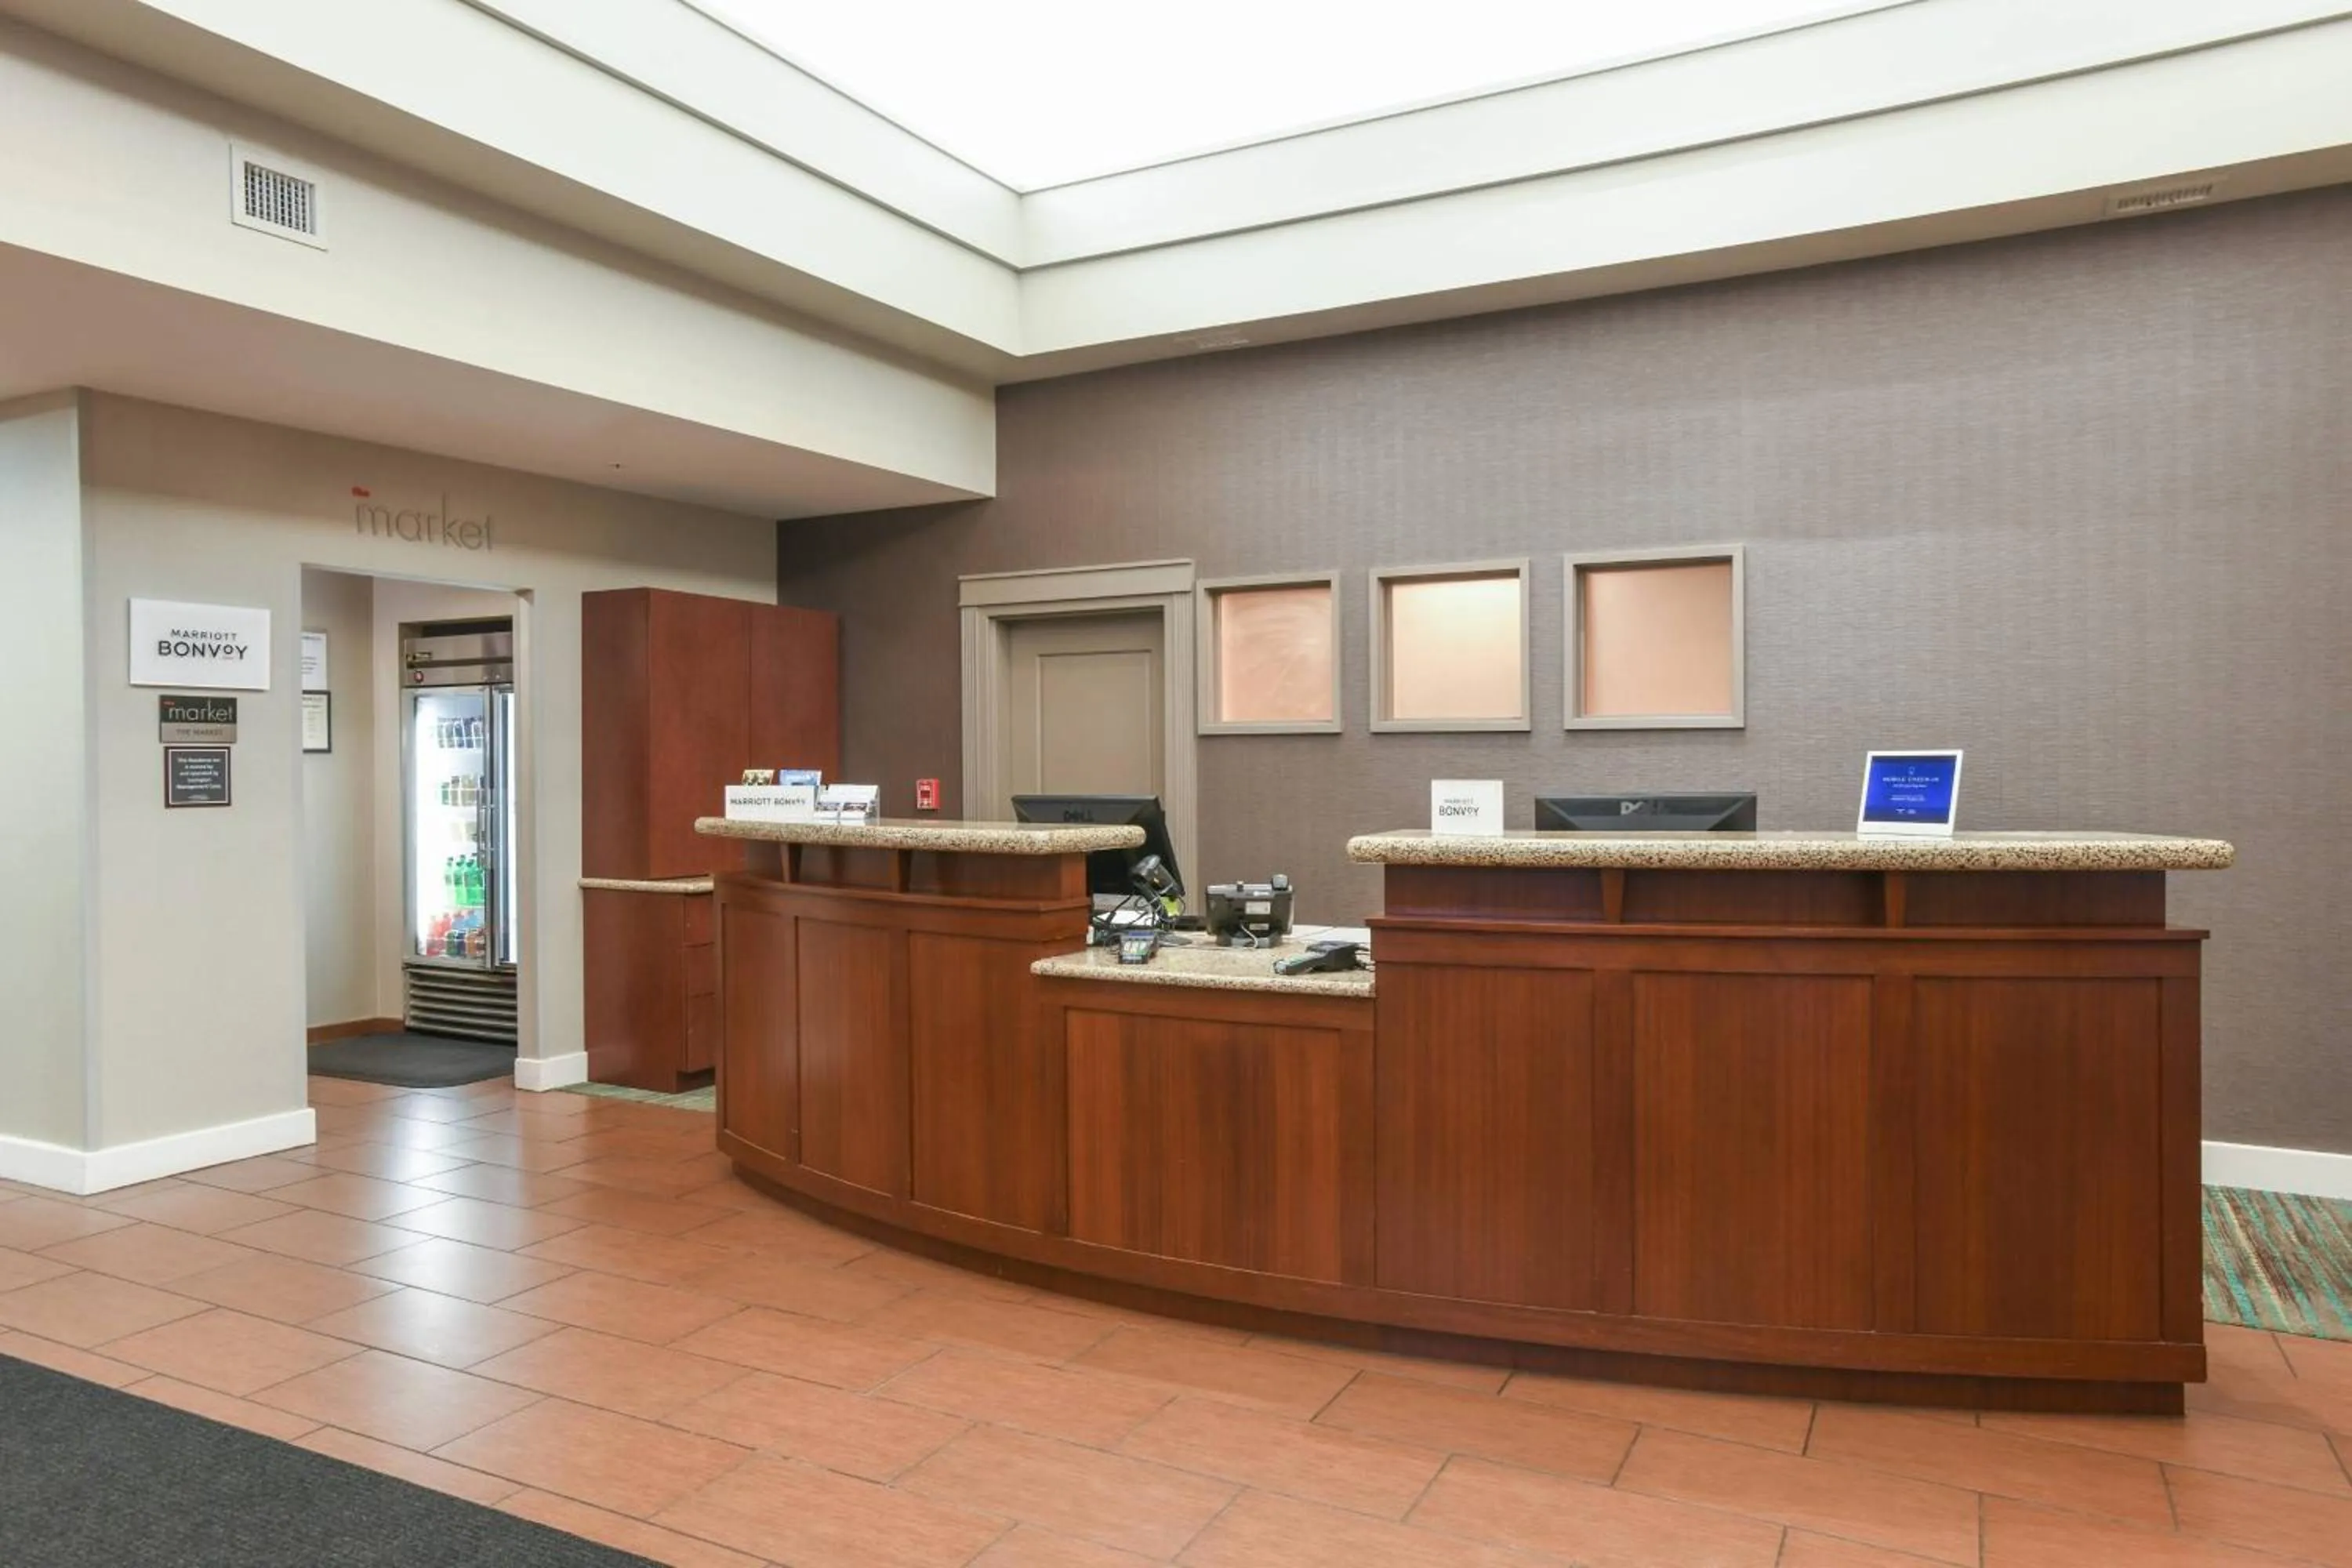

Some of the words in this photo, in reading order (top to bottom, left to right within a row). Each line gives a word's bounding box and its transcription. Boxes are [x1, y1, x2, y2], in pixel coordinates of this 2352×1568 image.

[355, 491, 492, 552] market
[171, 628, 238, 641] MARRIOTT
[158, 640, 248, 660] BONVOY
[168, 699, 234, 722] market
[730, 797, 771, 806] MARRIOTT
[1439, 805, 1479, 817] BONVOY
